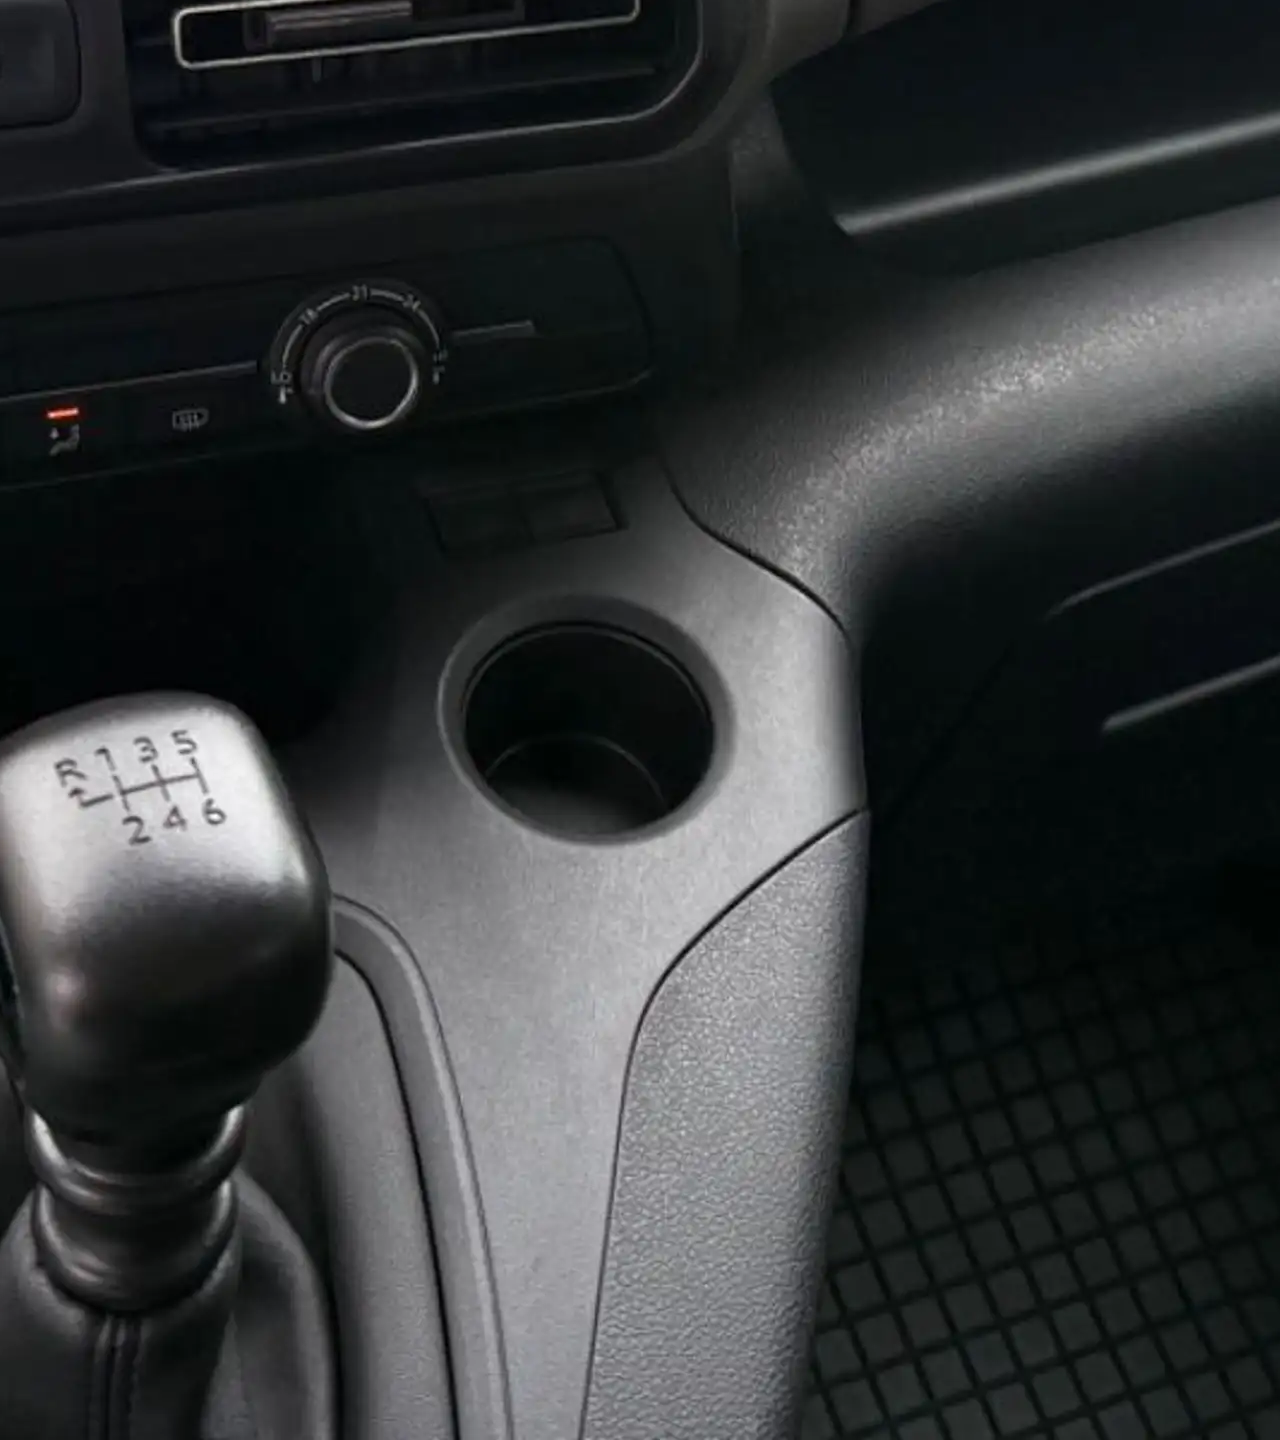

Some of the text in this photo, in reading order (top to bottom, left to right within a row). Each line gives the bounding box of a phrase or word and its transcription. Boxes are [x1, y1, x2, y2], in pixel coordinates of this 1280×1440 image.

[54, 728, 199, 788] R 1 3 5
[121, 797, 228, 846] 2 4 6
